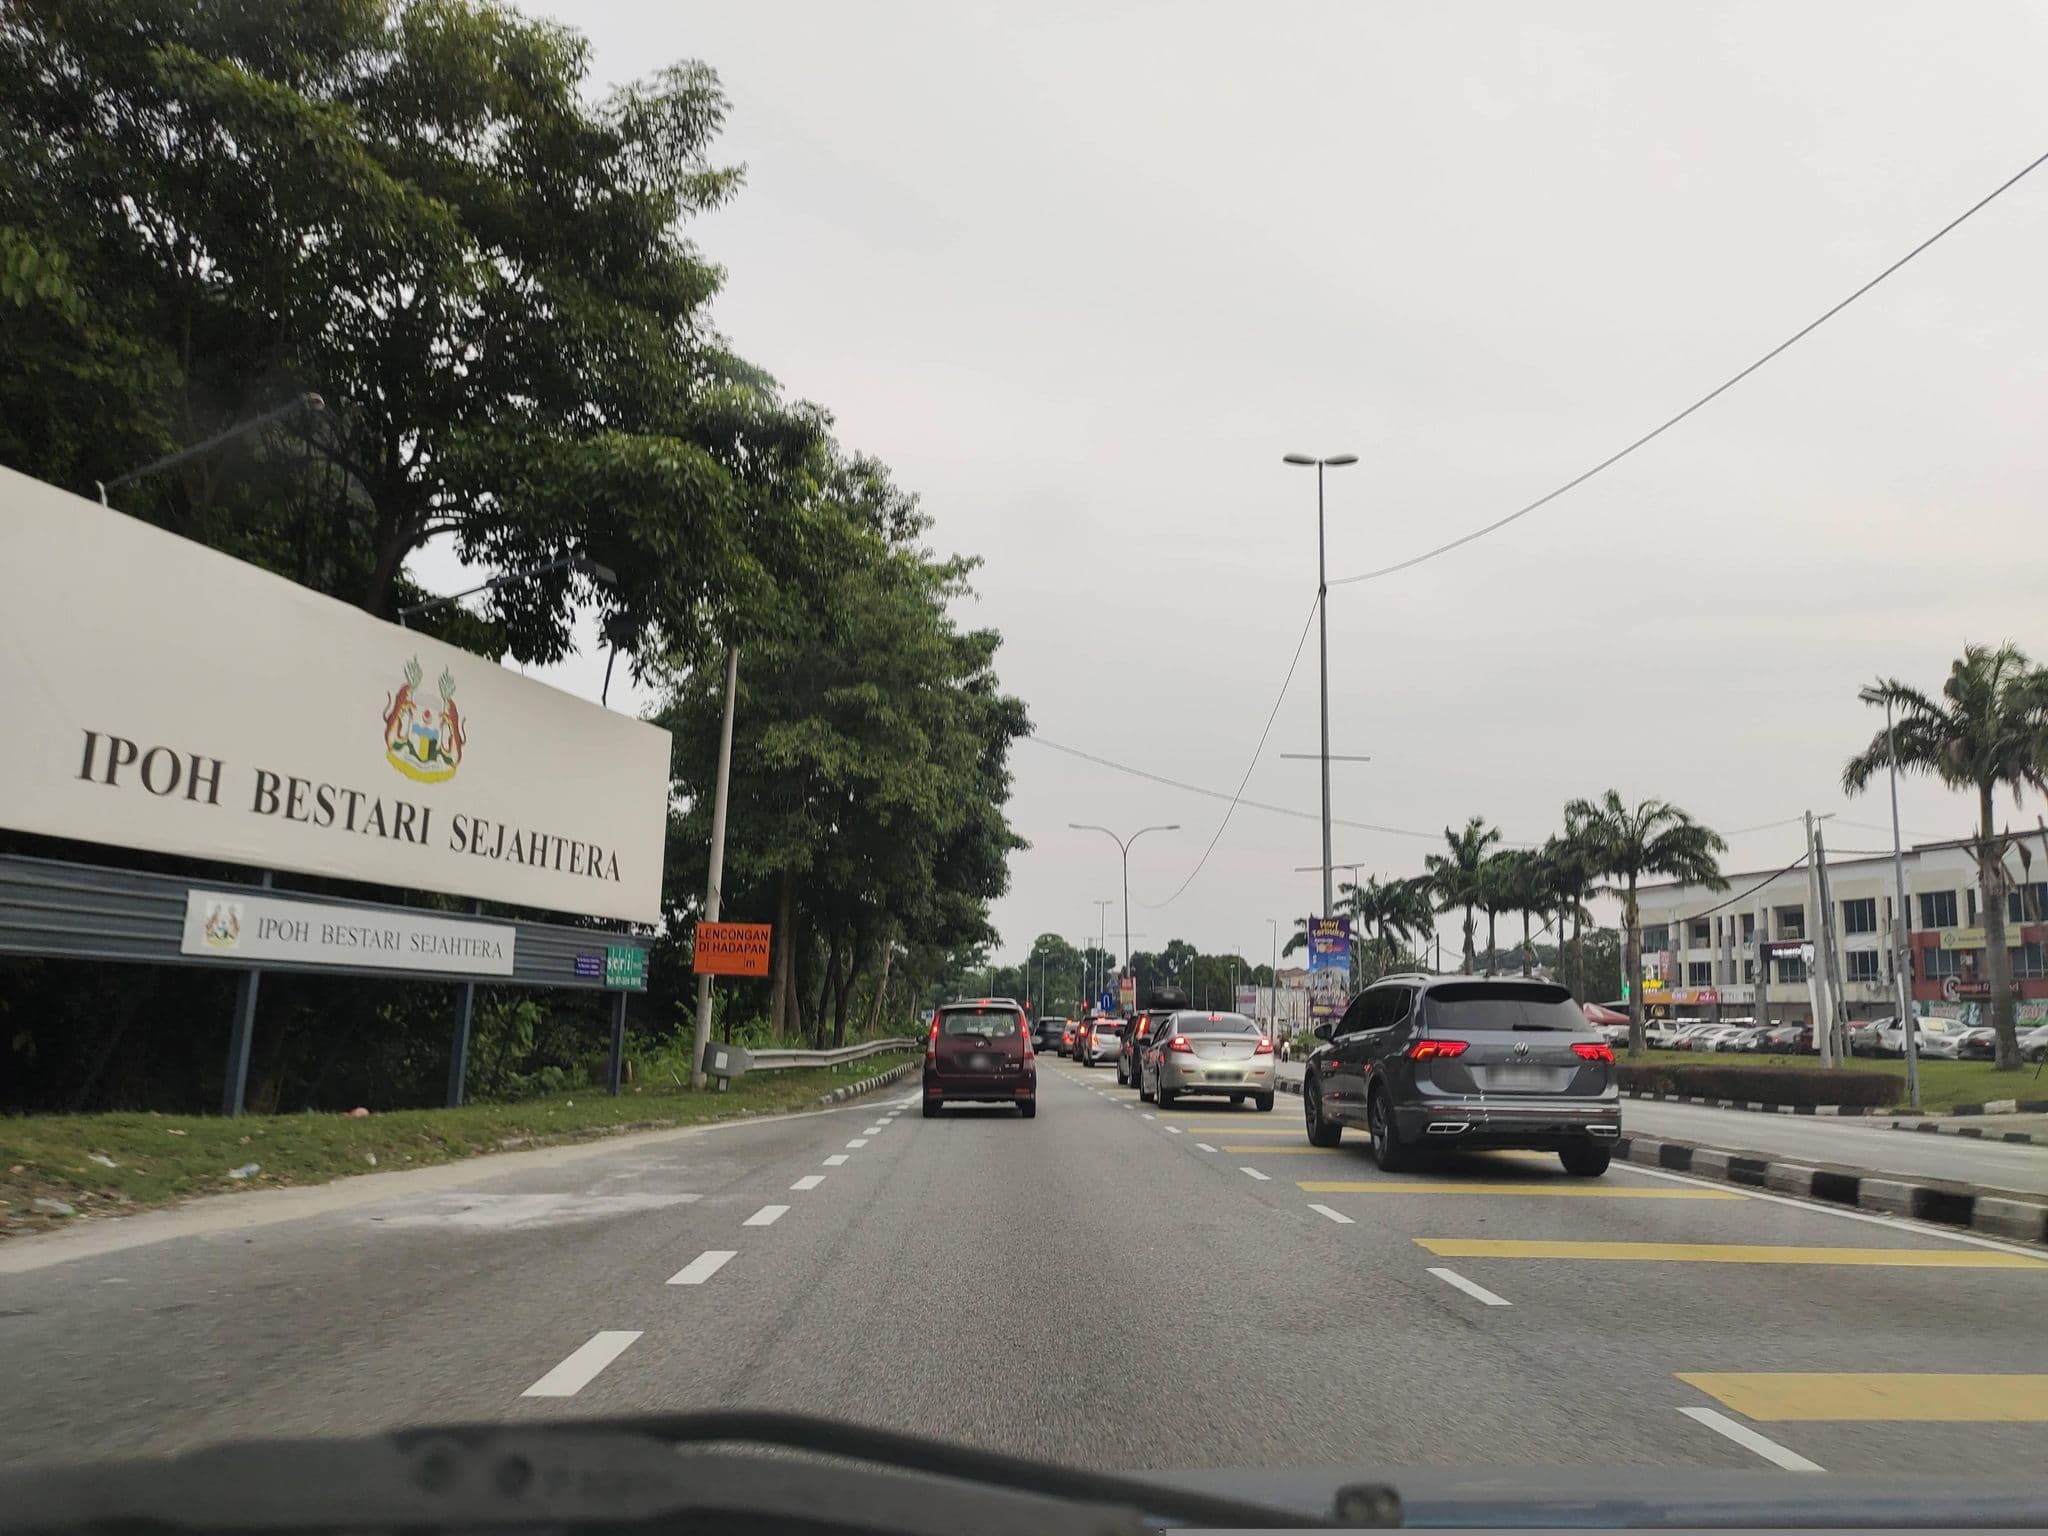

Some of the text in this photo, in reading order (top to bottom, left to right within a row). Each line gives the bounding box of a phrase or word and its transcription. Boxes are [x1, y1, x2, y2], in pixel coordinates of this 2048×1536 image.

[75, 728, 621, 882] IPOH BESTARI SEJAHTERA
[256, 917, 503, 959] IPOH BESTARI SEJAHTERA
[698, 927, 769, 941] LENCONGAN
[698, 941, 766, 955] DI HADAPAN
